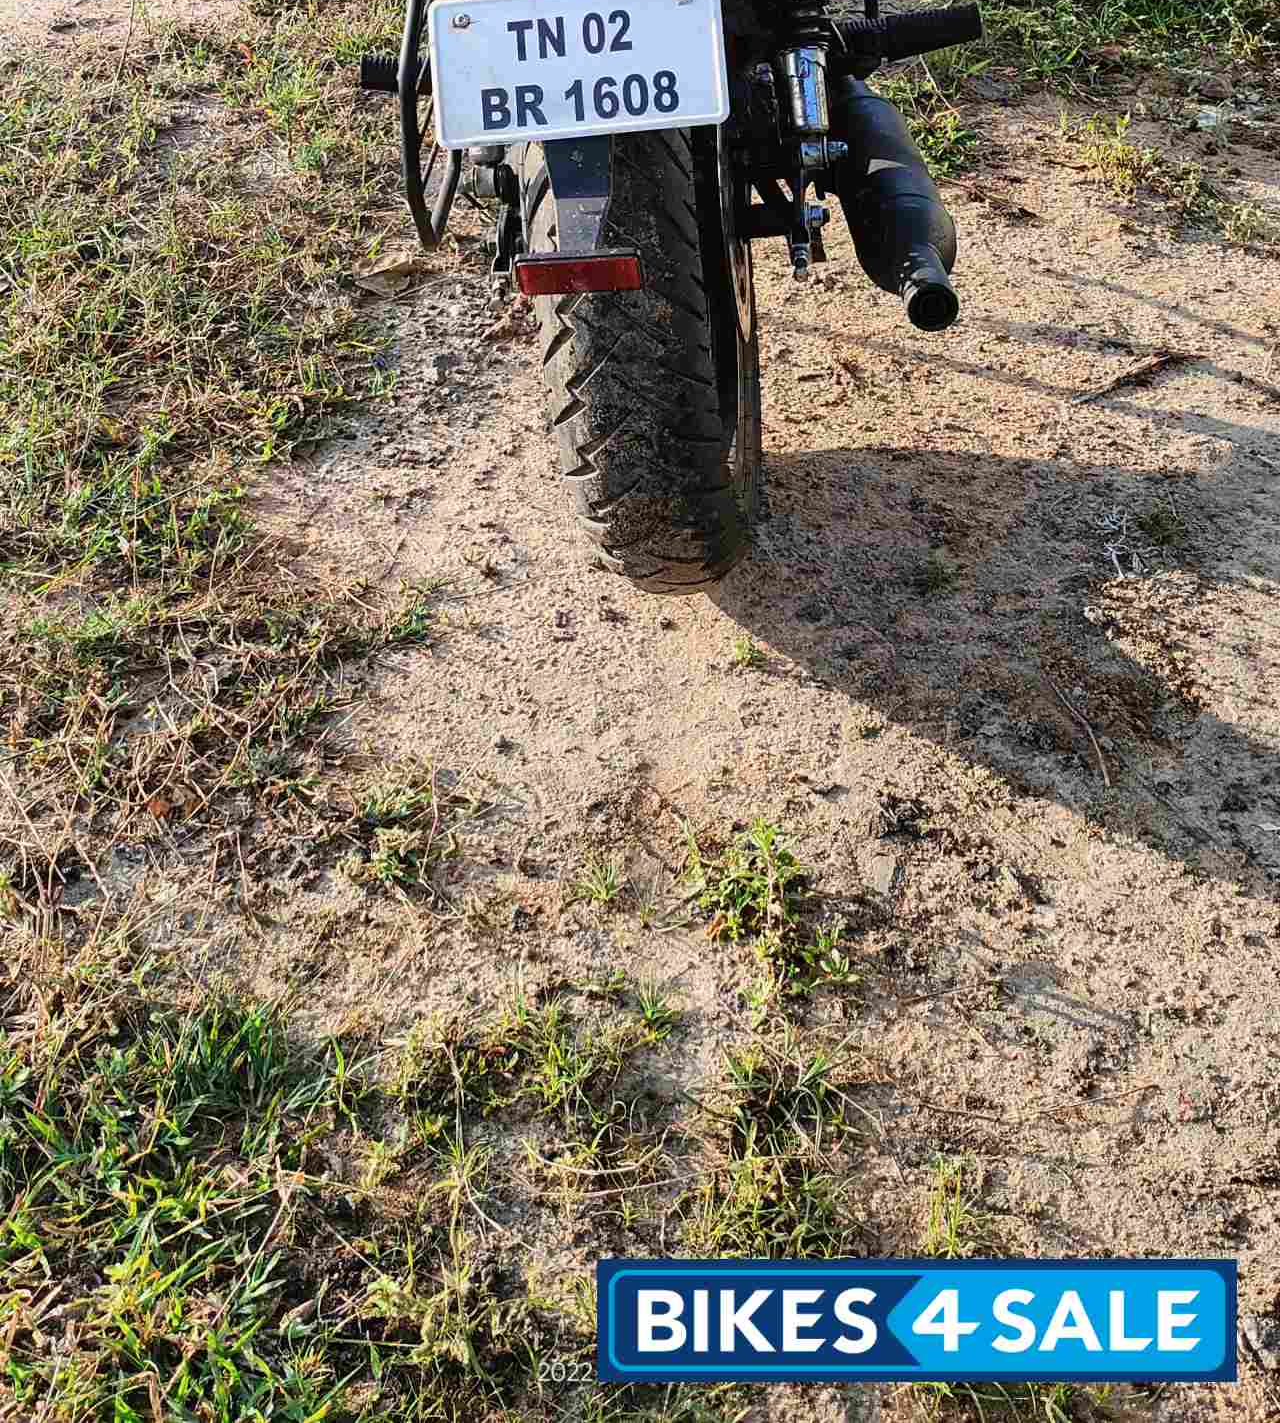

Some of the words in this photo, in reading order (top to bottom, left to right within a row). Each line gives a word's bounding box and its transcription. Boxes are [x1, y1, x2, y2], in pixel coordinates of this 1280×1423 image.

[507, 16, 566, 62] TN
[582, 9, 633, 54] 02
[481, 84, 548, 131] BR
[564, 70, 680, 122] 1608
